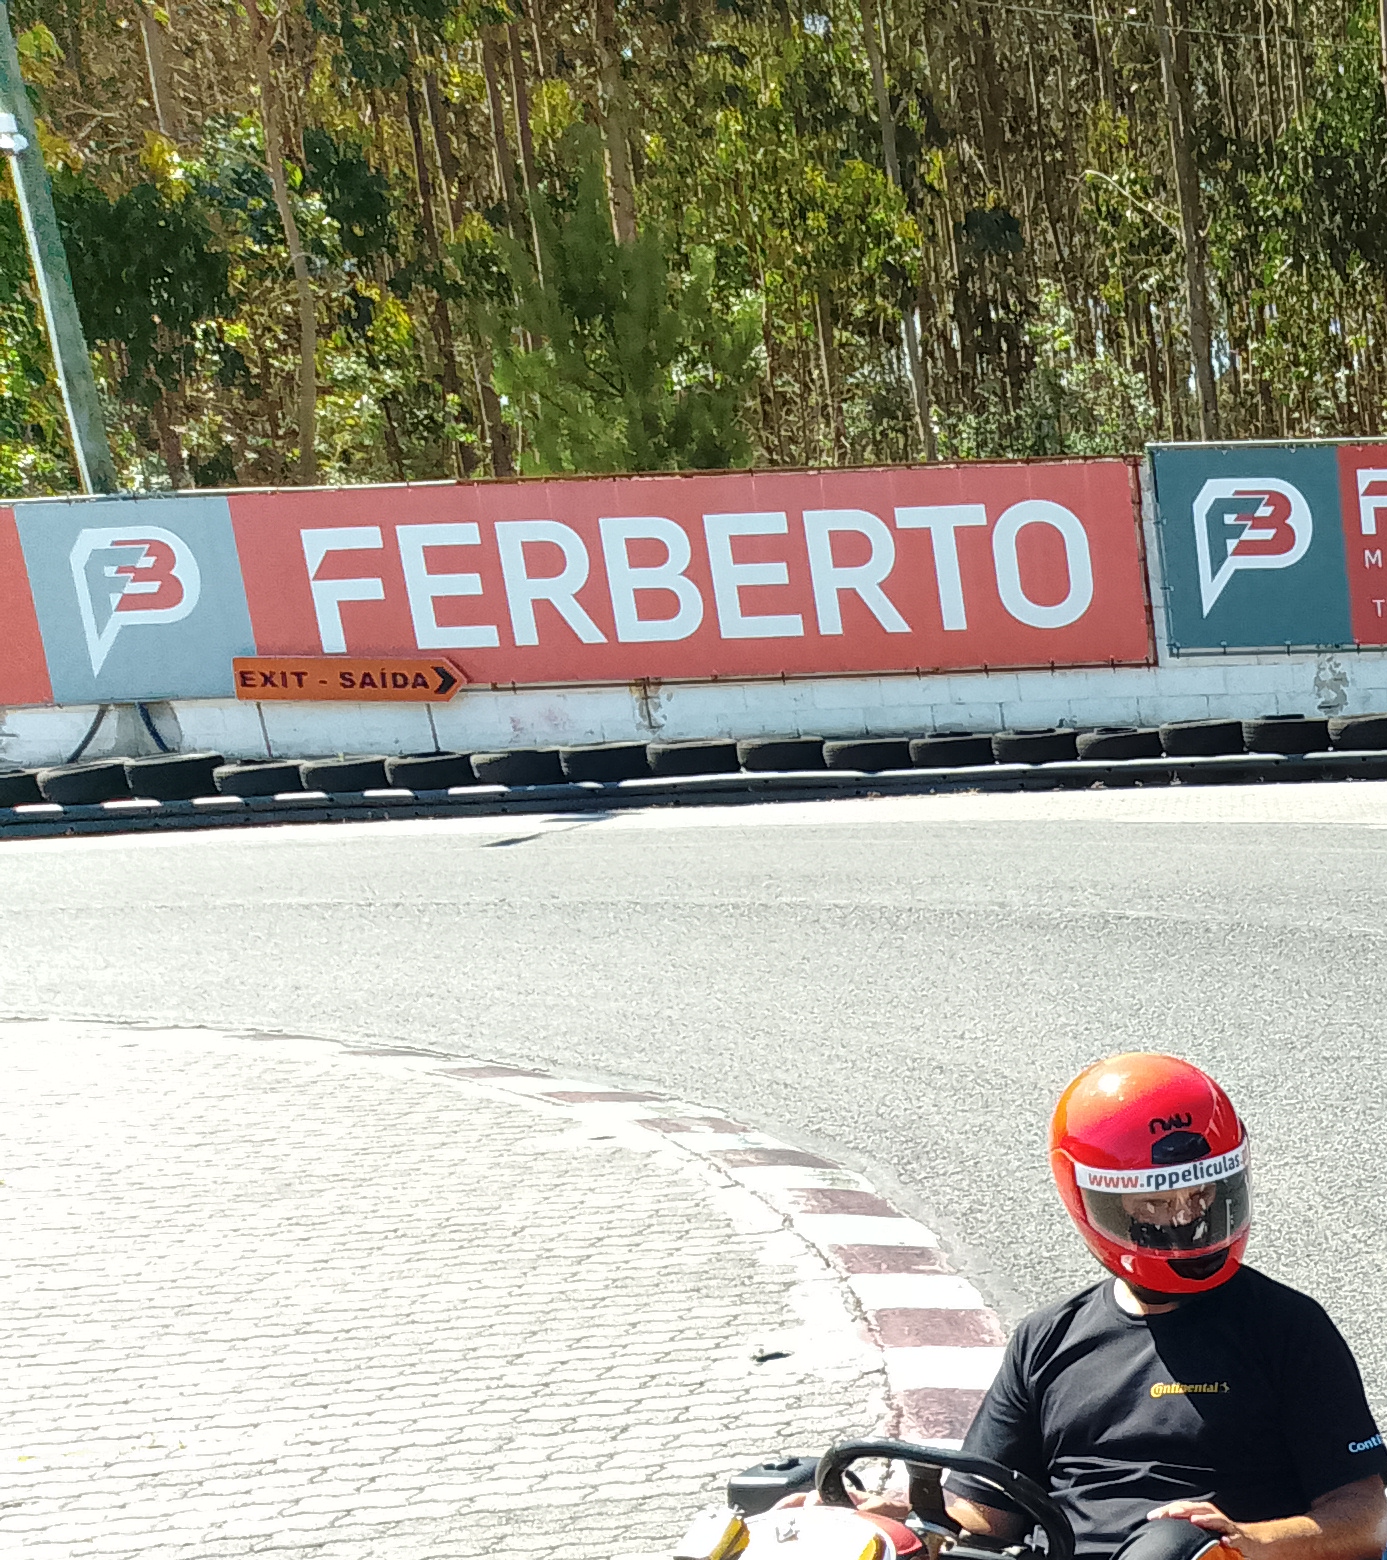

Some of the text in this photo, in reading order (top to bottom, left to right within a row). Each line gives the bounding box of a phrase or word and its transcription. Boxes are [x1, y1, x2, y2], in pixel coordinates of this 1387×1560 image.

[301, 499, 1094, 654] FERBERTO
[1373, 599, 1385, 617] T
[239, 671, 307, 691] EXIT
[338, 667, 429, 690] SAÍDA
